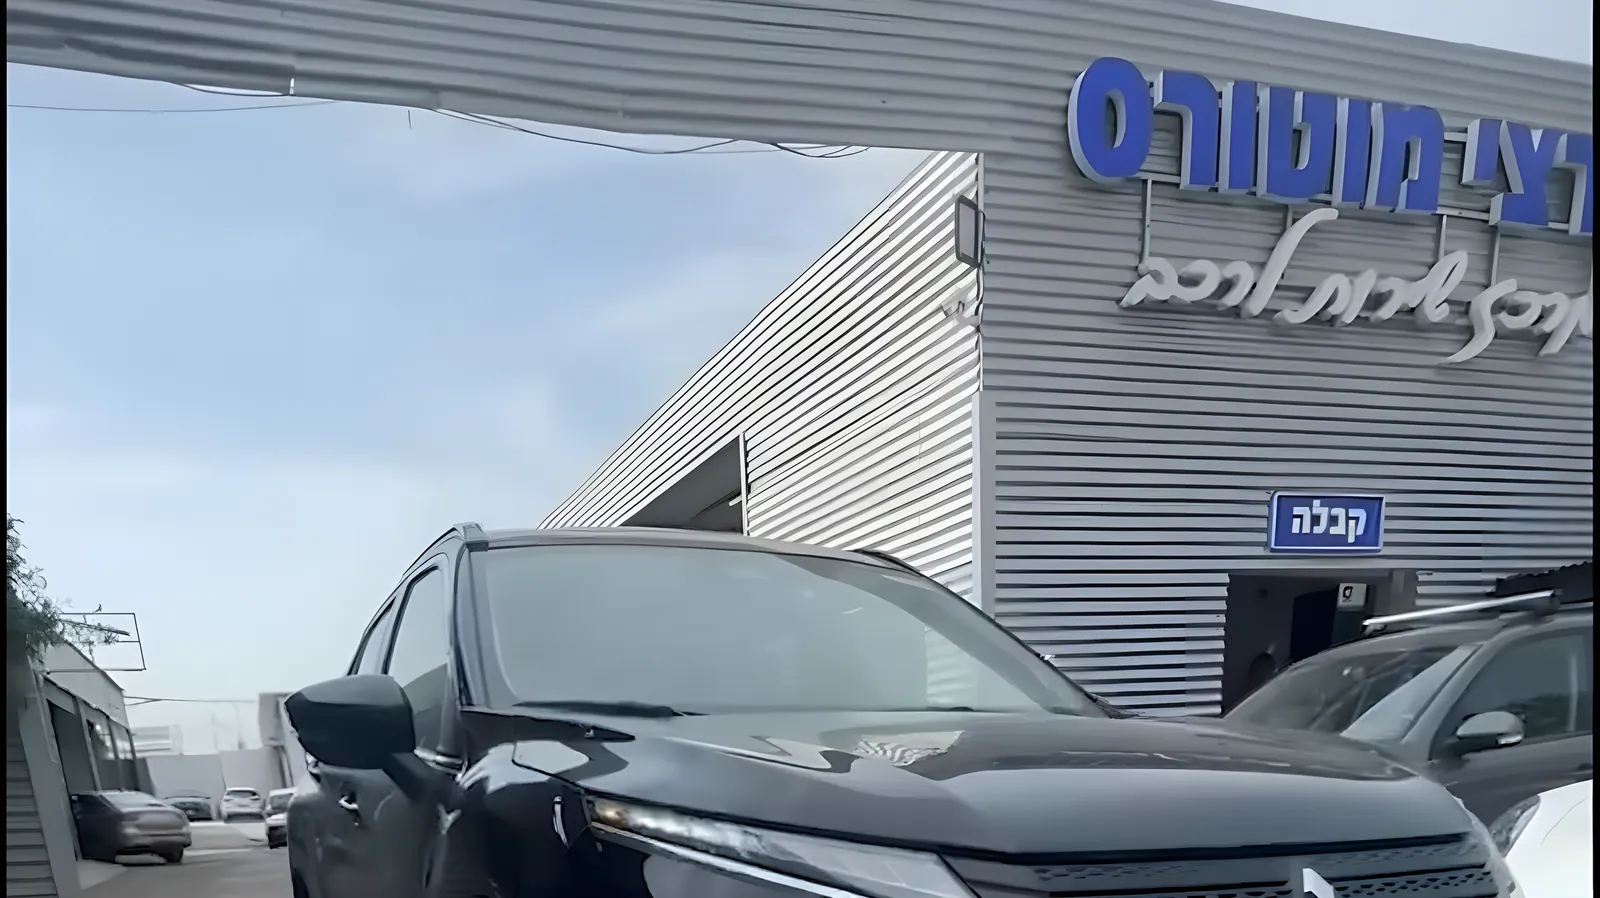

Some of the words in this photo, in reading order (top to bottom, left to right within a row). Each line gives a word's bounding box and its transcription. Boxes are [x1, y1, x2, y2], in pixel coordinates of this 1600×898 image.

[1067, 56, 1445, 215] מוטורס
[1116, 207, 1339, 319] לרכב
[1291, 499, 1367, 543] קבלה
